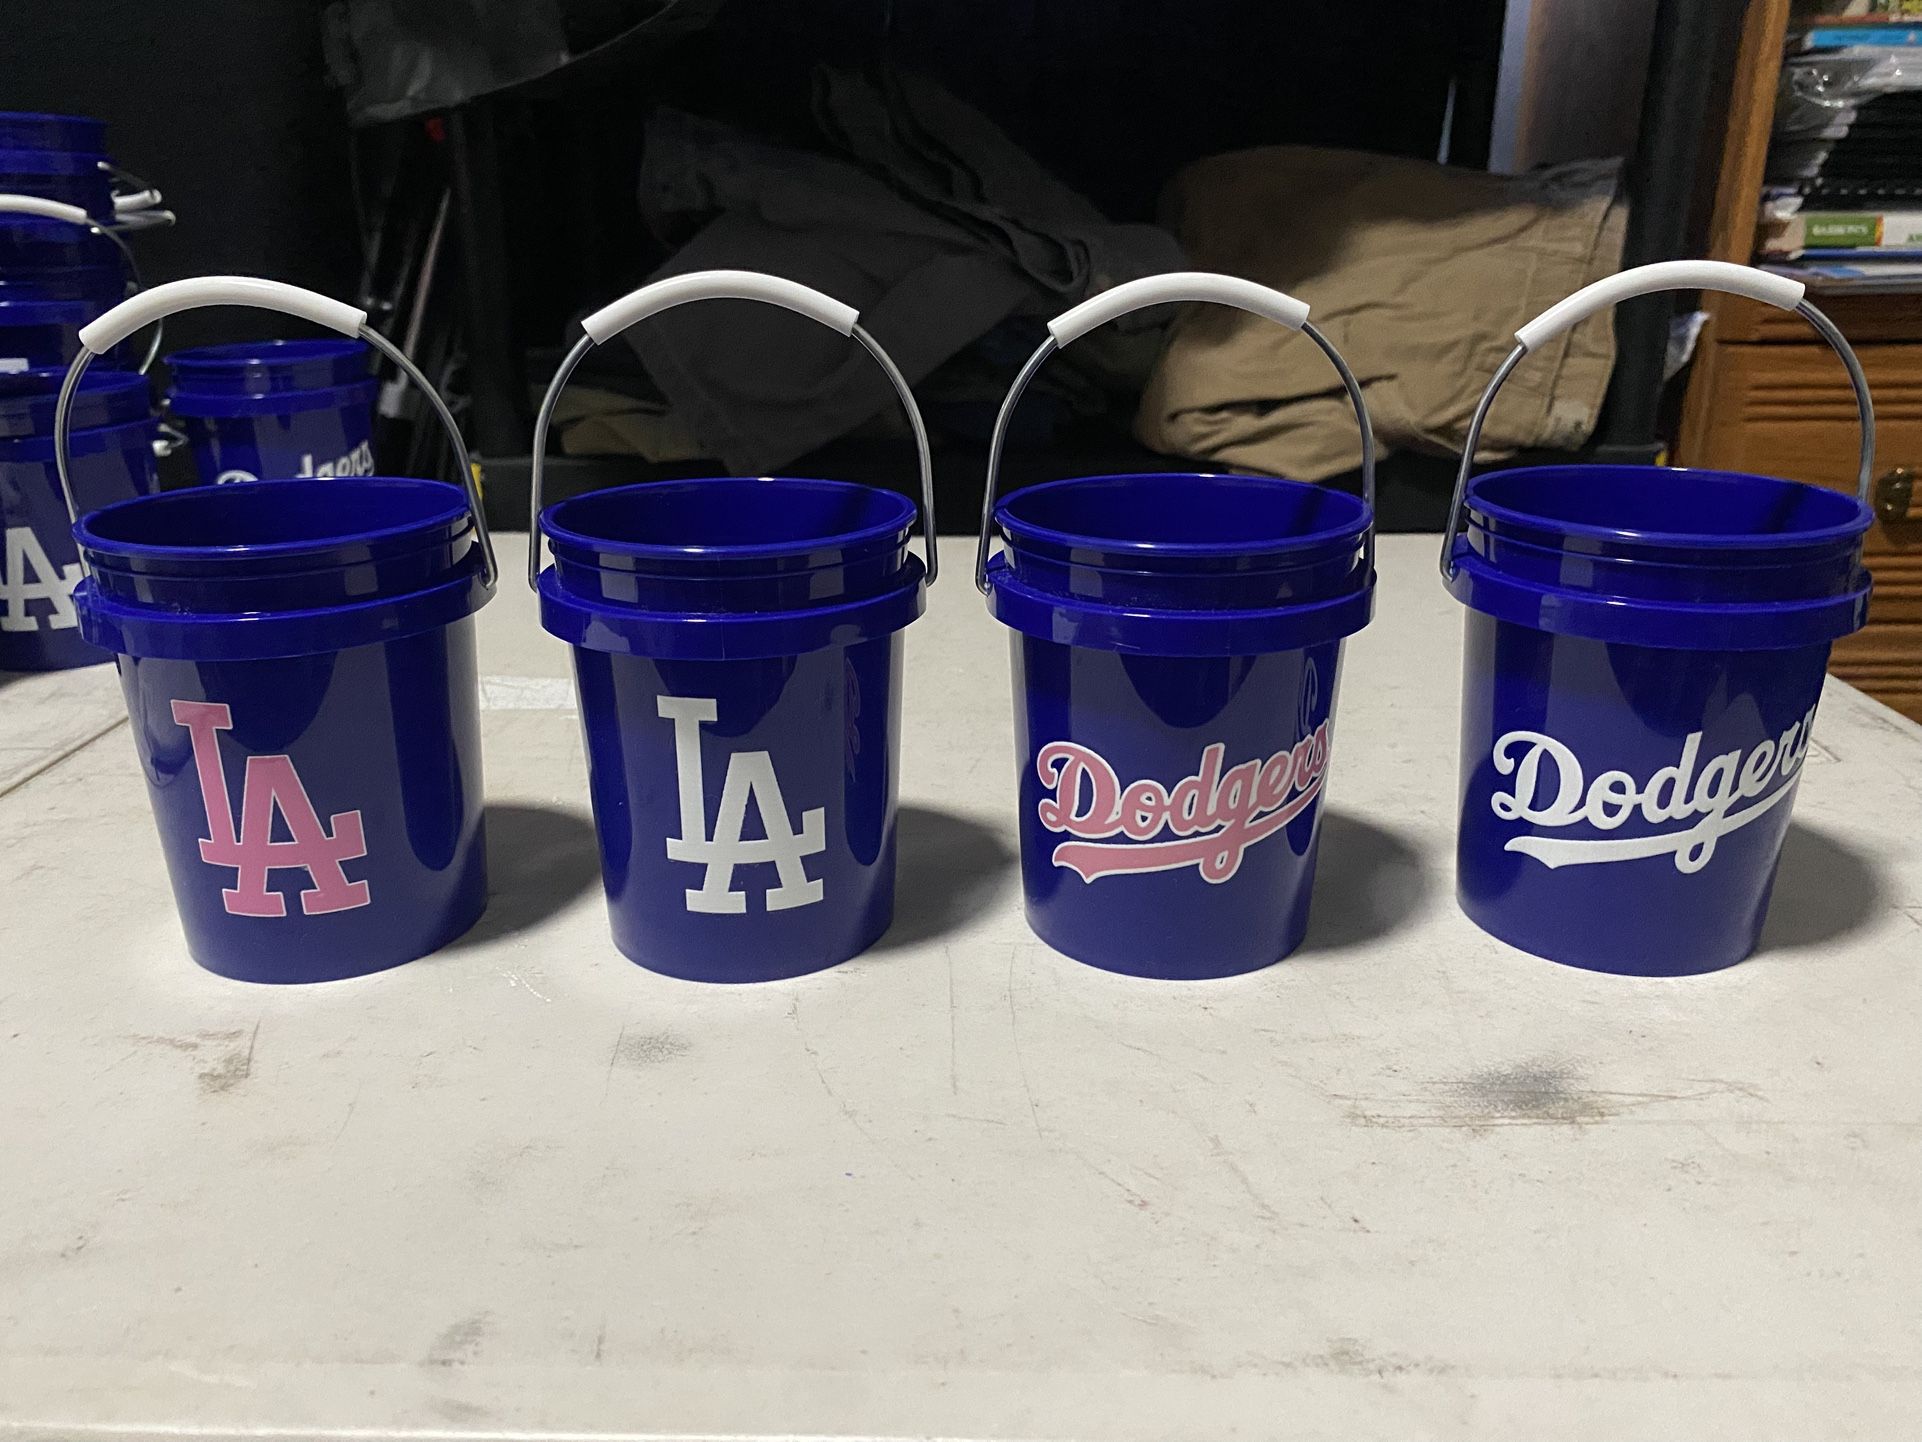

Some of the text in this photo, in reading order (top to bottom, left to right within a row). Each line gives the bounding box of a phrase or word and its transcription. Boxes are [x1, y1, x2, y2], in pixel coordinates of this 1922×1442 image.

[170, 699, 371, 917] LA
[657, 695, 826, 914] LA
[1037, 718, 1329, 884] Dodgers
